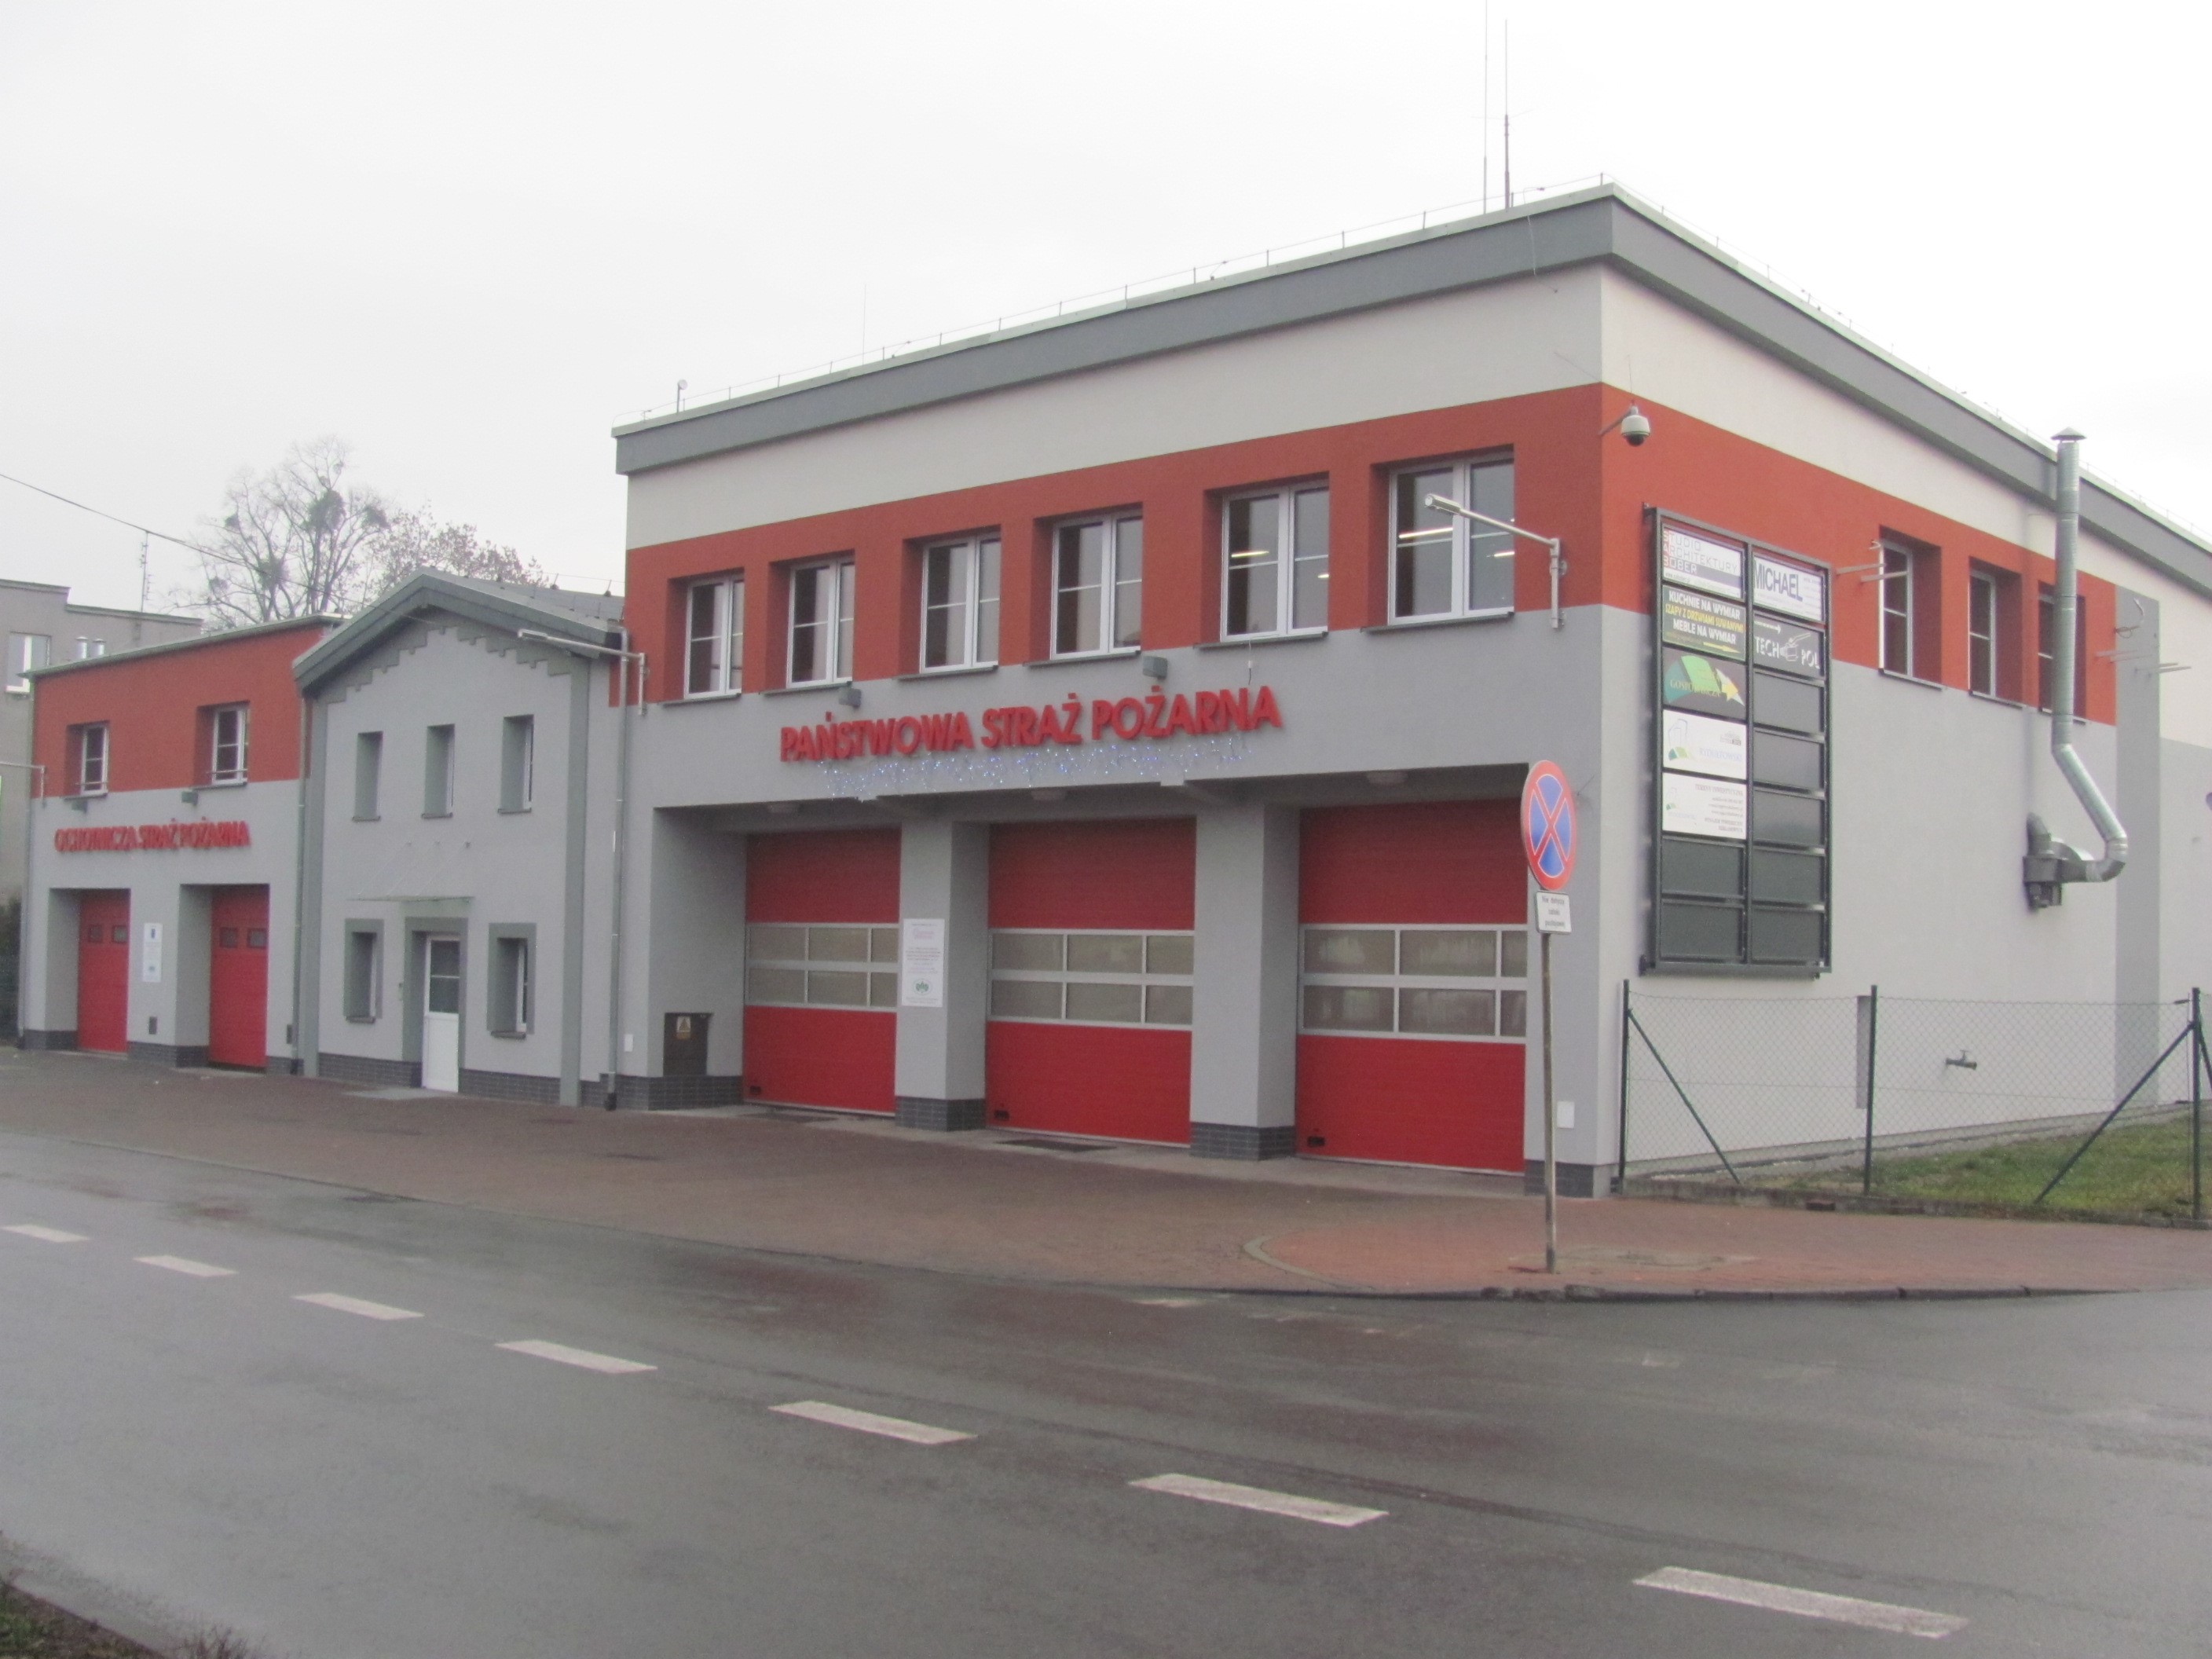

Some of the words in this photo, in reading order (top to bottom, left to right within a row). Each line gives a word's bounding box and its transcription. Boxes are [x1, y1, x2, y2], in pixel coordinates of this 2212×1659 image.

[1663, 530, 1701, 551] STUDIO
[1663, 543, 1738, 575] ARCHITEKTURY
[1663, 555, 1697, 575] BOBER
[1753, 558, 1804, 602] MICHAEL
[1669, 590, 1700, 610] KUCHNIE
[1701, 599, 1712, 613] NA
[1712, 602, 1741, 621] WYMIAR
[1672, 618, 1696, 635] MEBLE
[1697, 624, 1707, 638] NA
[1708, 628, 1737, 645] WYMIAR
[1753, 635, 1780, 659] TECH
[1801, 648, 1821, 669] POL
[780, 711, 975, 762] PAŃSTWOWA
[981, 692, 1083, 749] STRAŻ
[1091, 684, 1283, 741] POŻARNA
